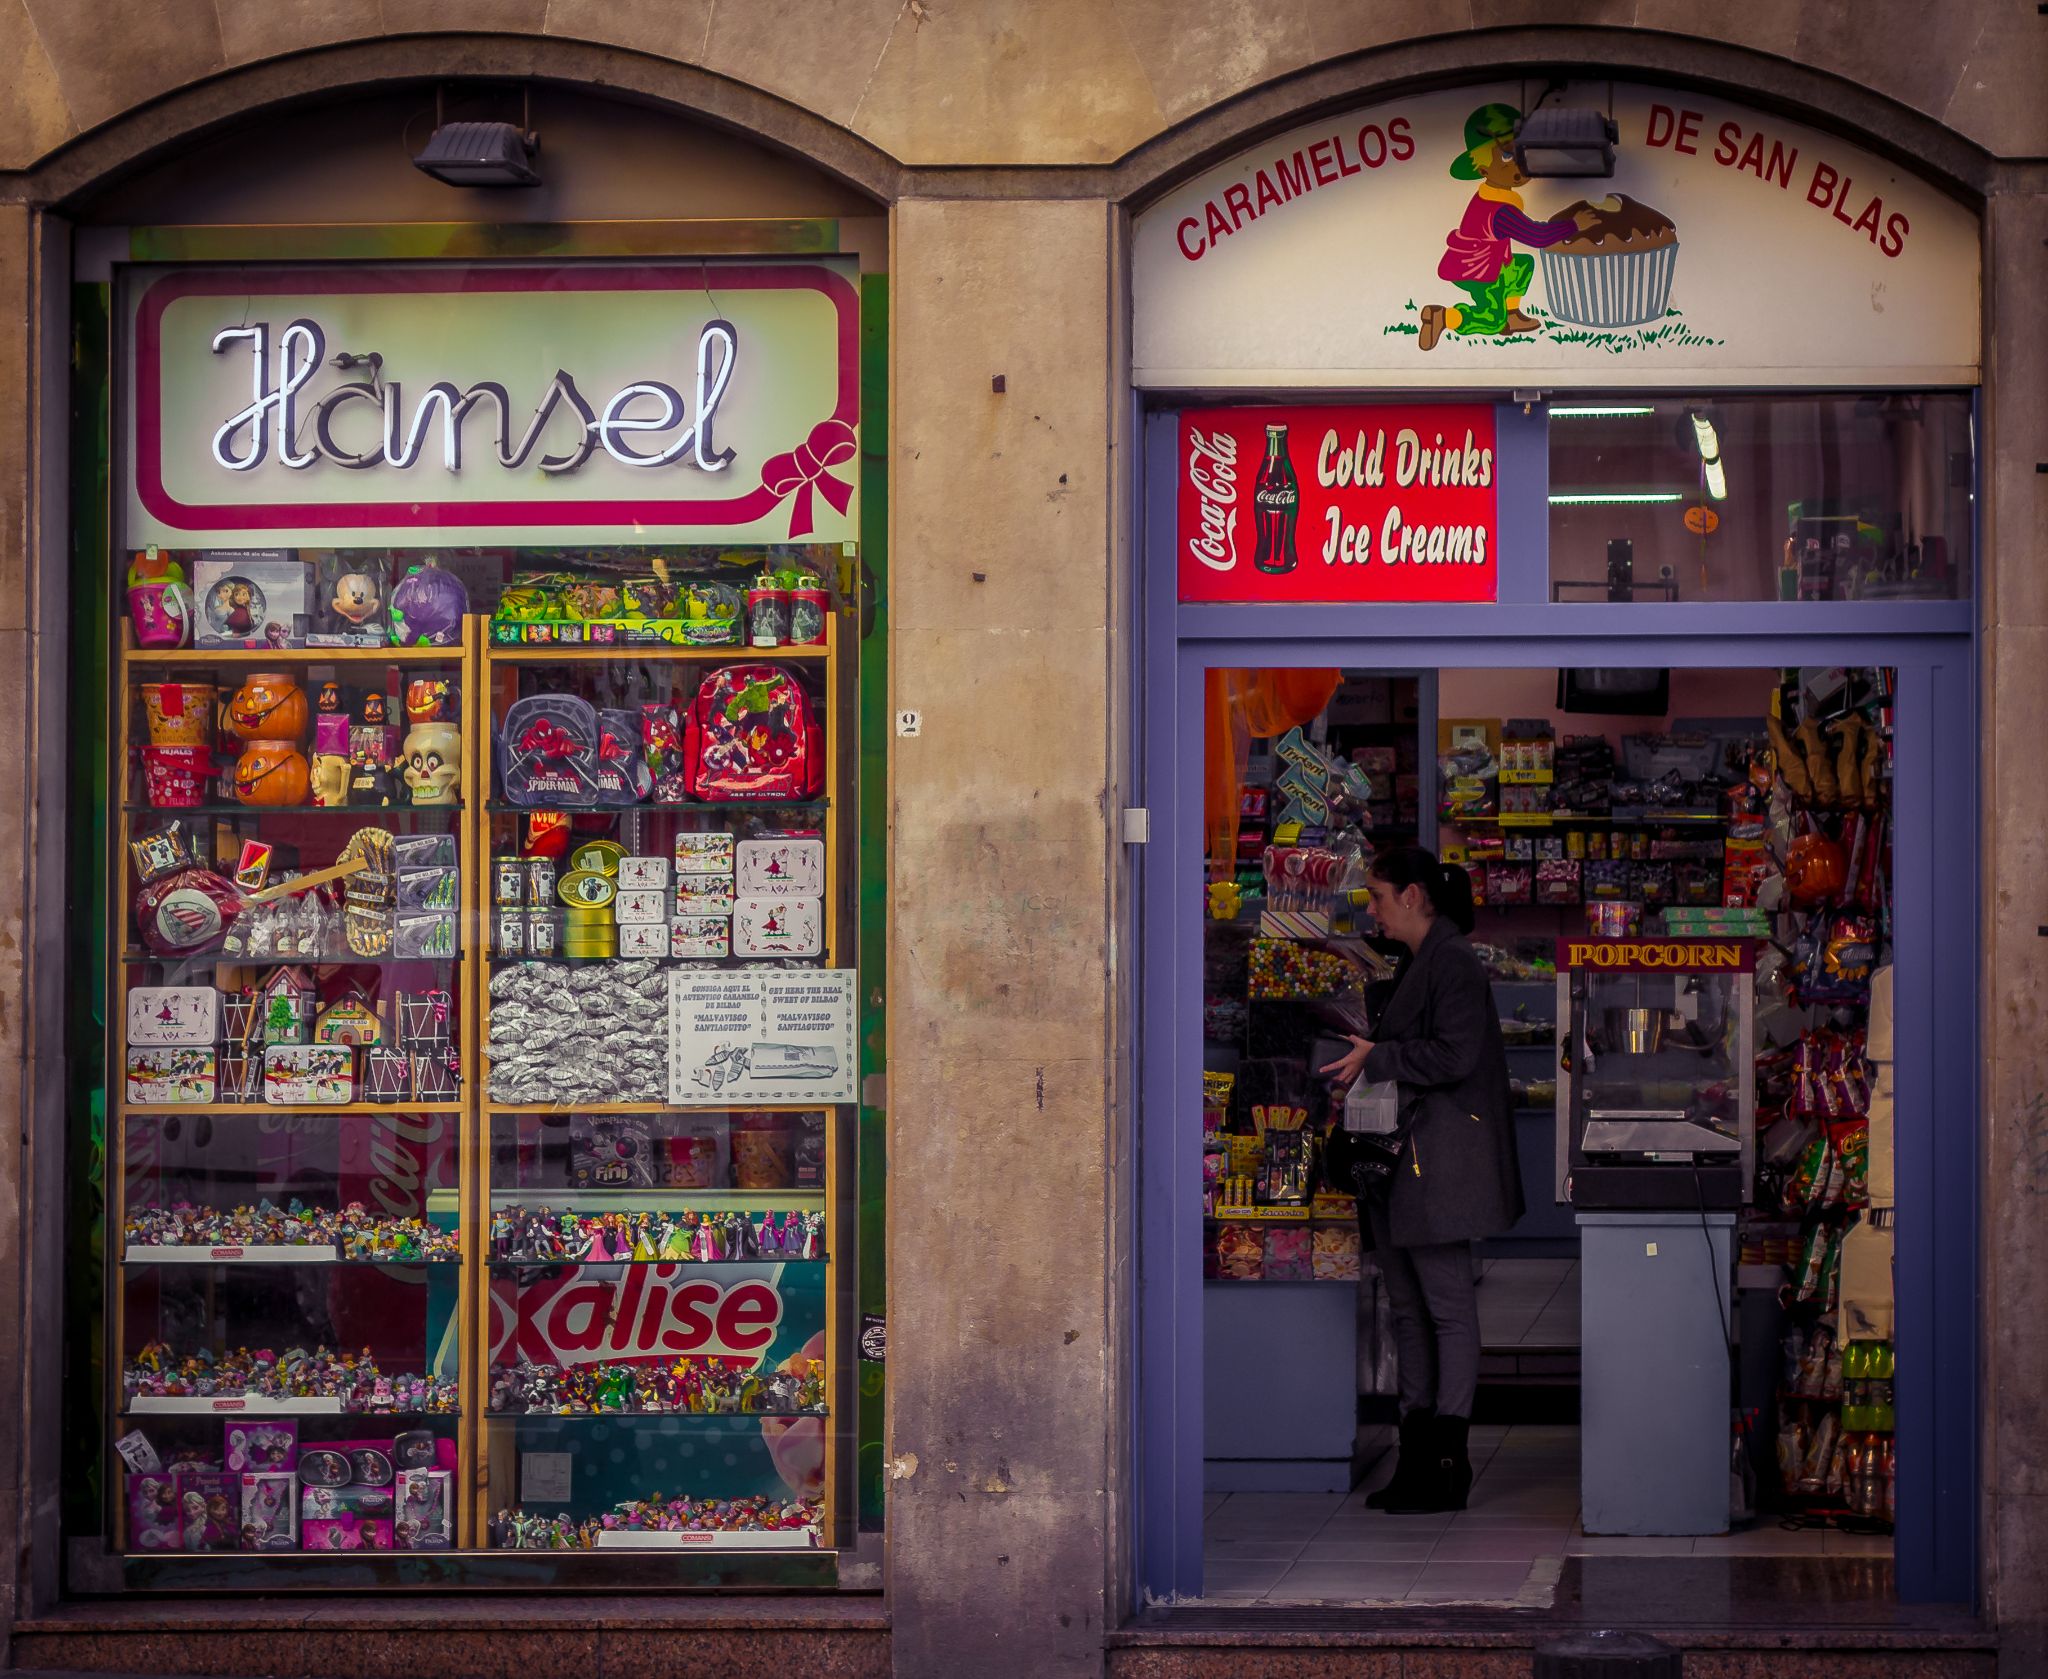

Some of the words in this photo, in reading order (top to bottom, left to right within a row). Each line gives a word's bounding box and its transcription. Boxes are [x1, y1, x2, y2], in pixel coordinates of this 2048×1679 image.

[1176, 117, 1416, 261] CARAMELOS
[1645, 103, 1704, 156] DE
[1713, 121, 1799, 190] SAN
[1806, 160, 1910, 258] BLAS
[1317, 428, 1385, 488] Cold
[1396, 427, 1492, 488] Drinks
[1188, 426, 1239, 571] Coca-Cola
[1256, 489, 1296, 504] Coca-Cola
[1322, 504, 1370, 565] Ice
[1380, 504, 1487, 565] Creams
[902, 712, 916, 733] 2
[1282, 745, 1327, 777] Trident
[526, 779, 580, 795] SPIDER-MAN
[1282, 779, 1325, 812] Trident
[1568, 944, 1742, 967] POPCORN
[682, 993, 722, 1001] AUTENTICO
[722, 993, 760, 1001] CARAMELO
[691, 985, 722, 993] CONSIGA
[722, 985, 744, 993] AQUI
[743, 985, 751, 993] EL
[768, 987, 781, 995] GET
[782, 987, 805, 995] HERE
[805, 986, 822, 994] THE
[822, 987, 843, 995] REAL
[772, 996, 800, 1004] SWEET
[800, 996, 810, 1004] OF
